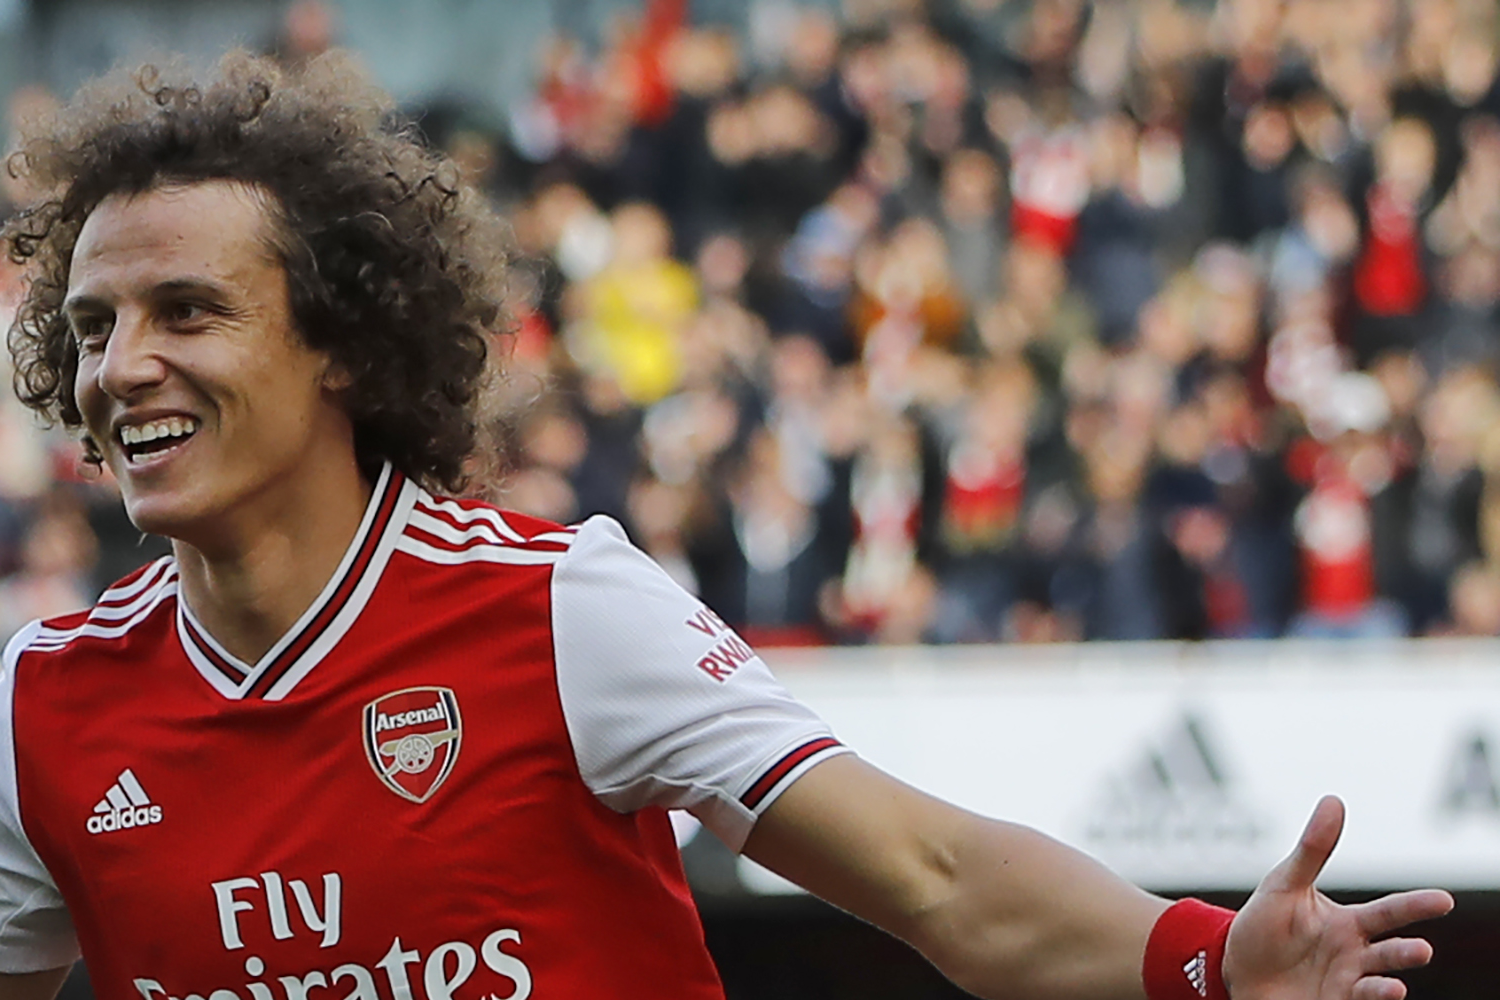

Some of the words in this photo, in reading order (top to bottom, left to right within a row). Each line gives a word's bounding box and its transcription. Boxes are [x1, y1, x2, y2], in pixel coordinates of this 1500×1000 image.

[376, 702, 445, 732] Arsenal
[86, 805, 163, 834] adidas
[211, 871, 342, 949] Fly
